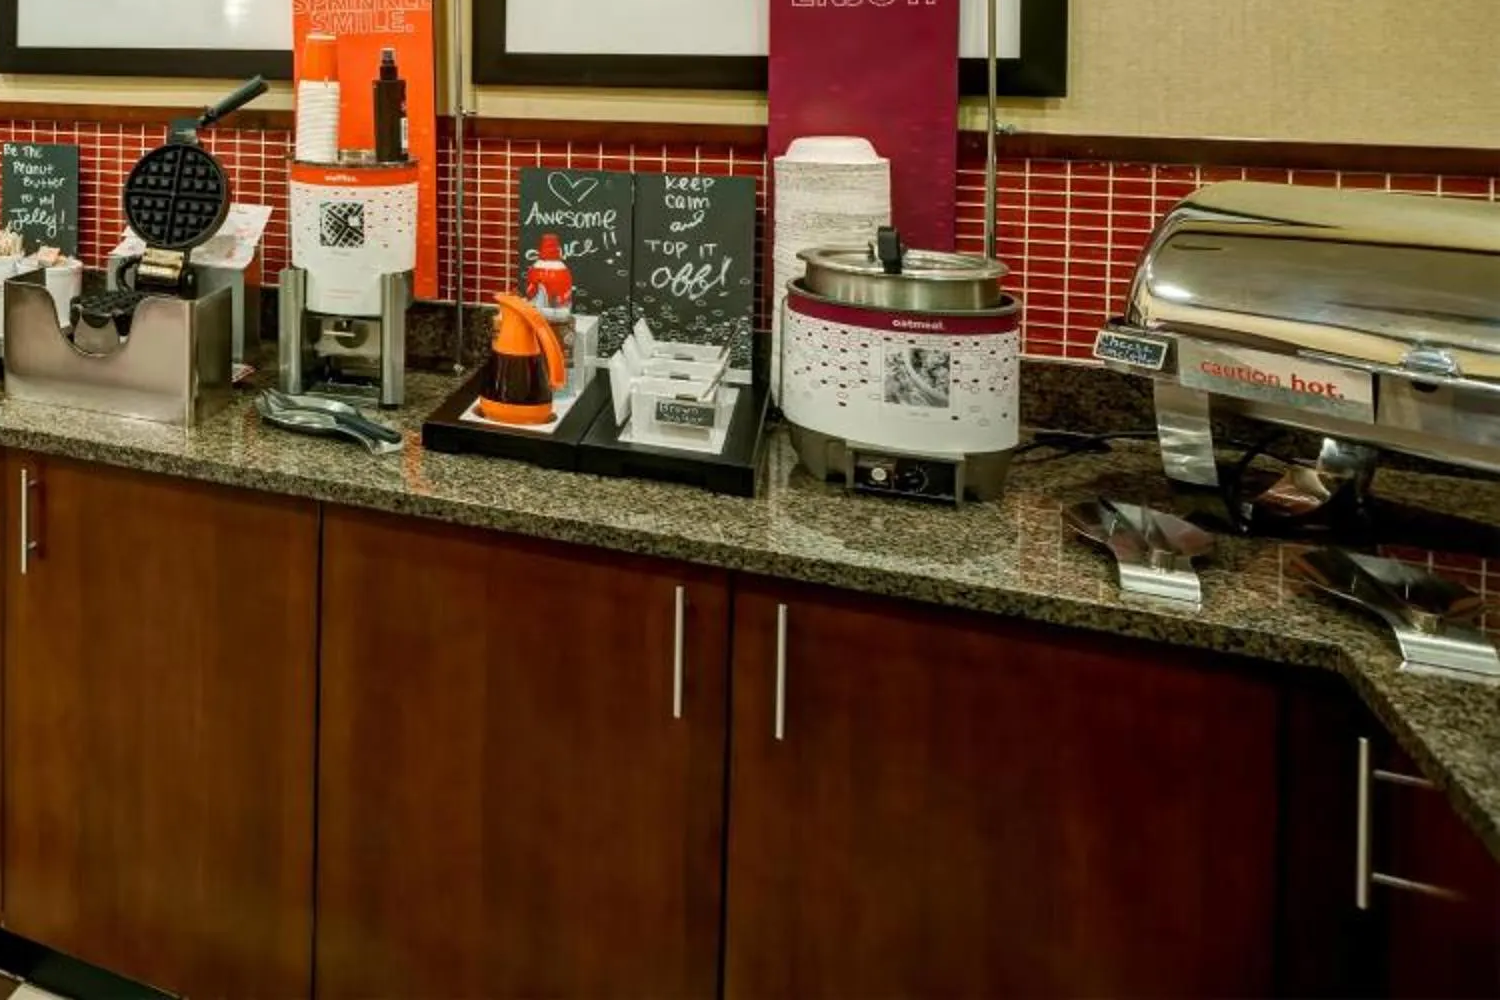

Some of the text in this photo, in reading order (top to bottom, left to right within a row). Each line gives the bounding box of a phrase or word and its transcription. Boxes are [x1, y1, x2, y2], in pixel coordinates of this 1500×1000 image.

[309, 9, 415, 34] SMILE.
[3, 144, 18, 157] Be
[12, 161, 54, 175] Peanut
[524, 201, 617, 230] Awesome
[644, 239, 718, 259] TOP IT
[1199, 360, 1345, 400] caution hot.
